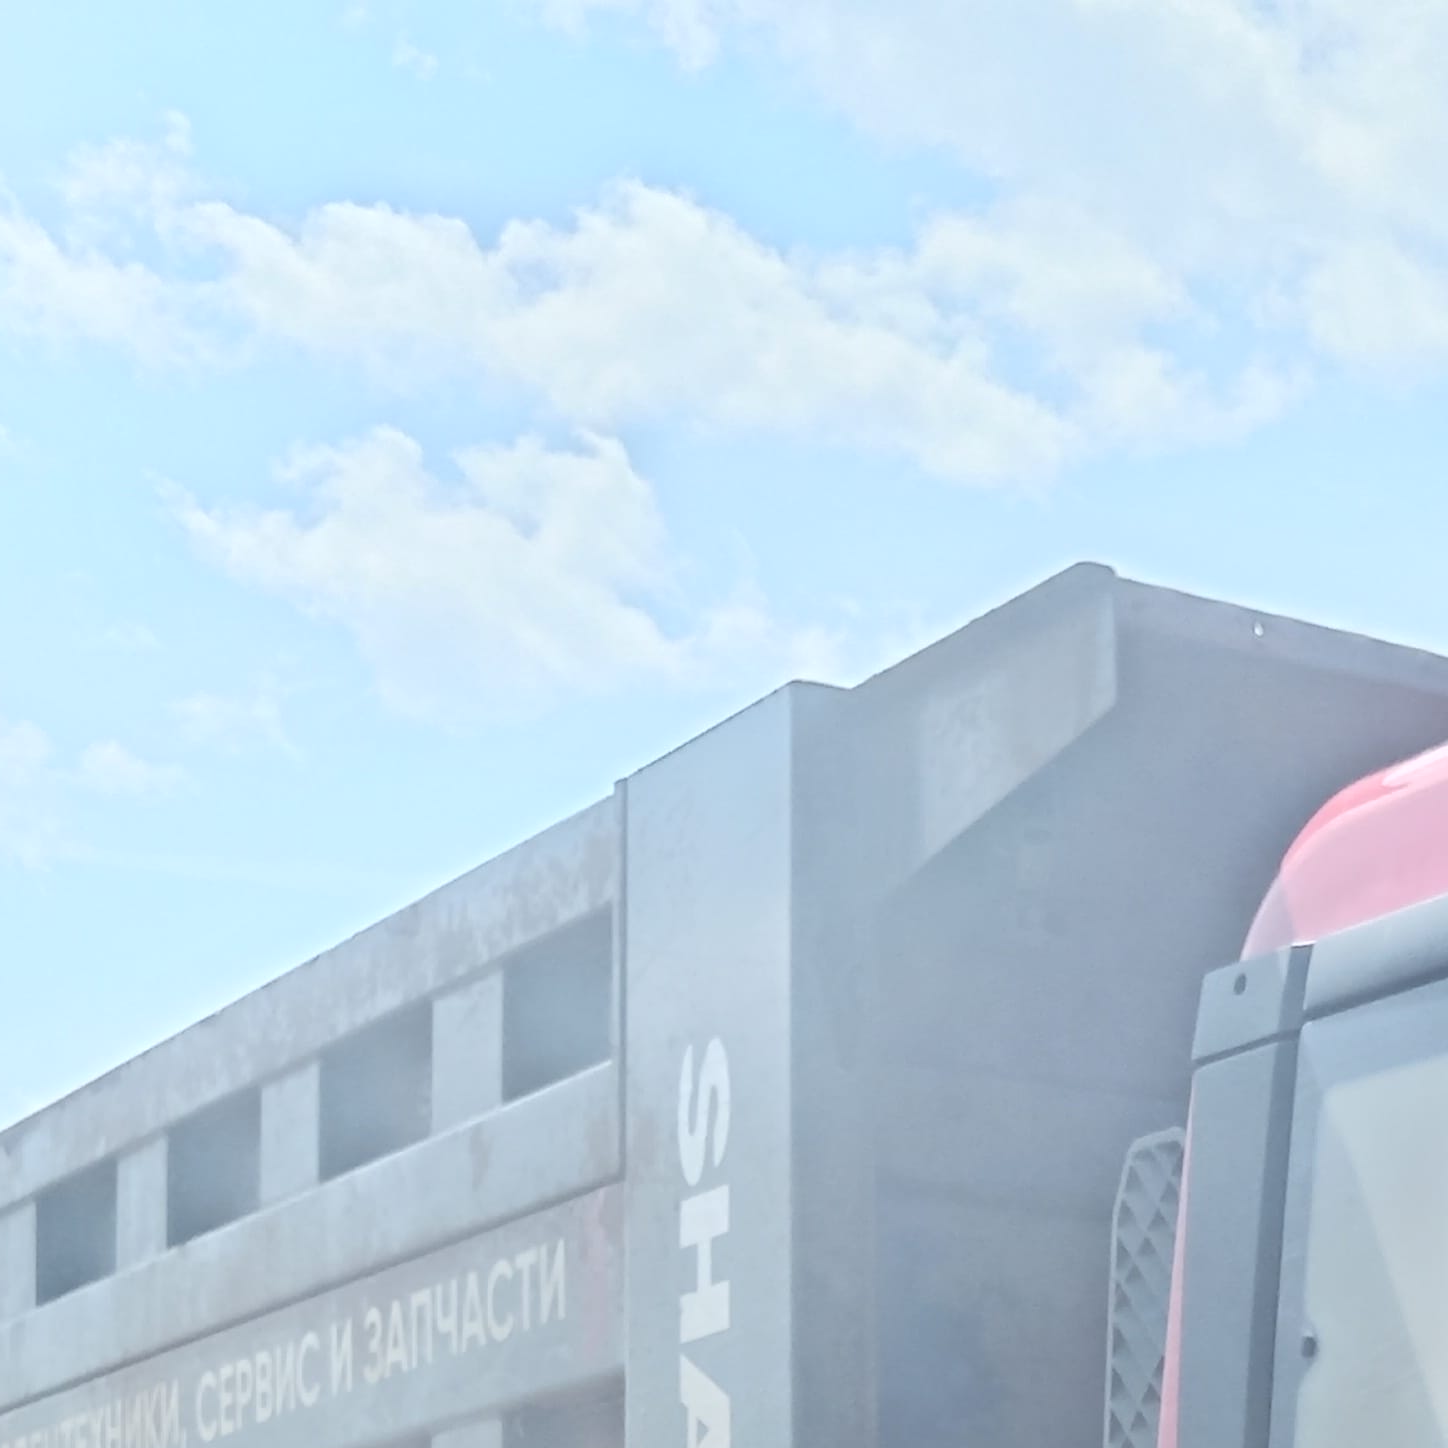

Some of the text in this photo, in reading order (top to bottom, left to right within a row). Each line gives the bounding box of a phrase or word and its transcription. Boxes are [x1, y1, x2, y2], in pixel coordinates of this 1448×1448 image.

[195, 1331, 321, 1442] СЕРВИС
[330, 1317, 353, 1398] И
[363, 1238, 566, 1384] ЗАПЧАСТИ
